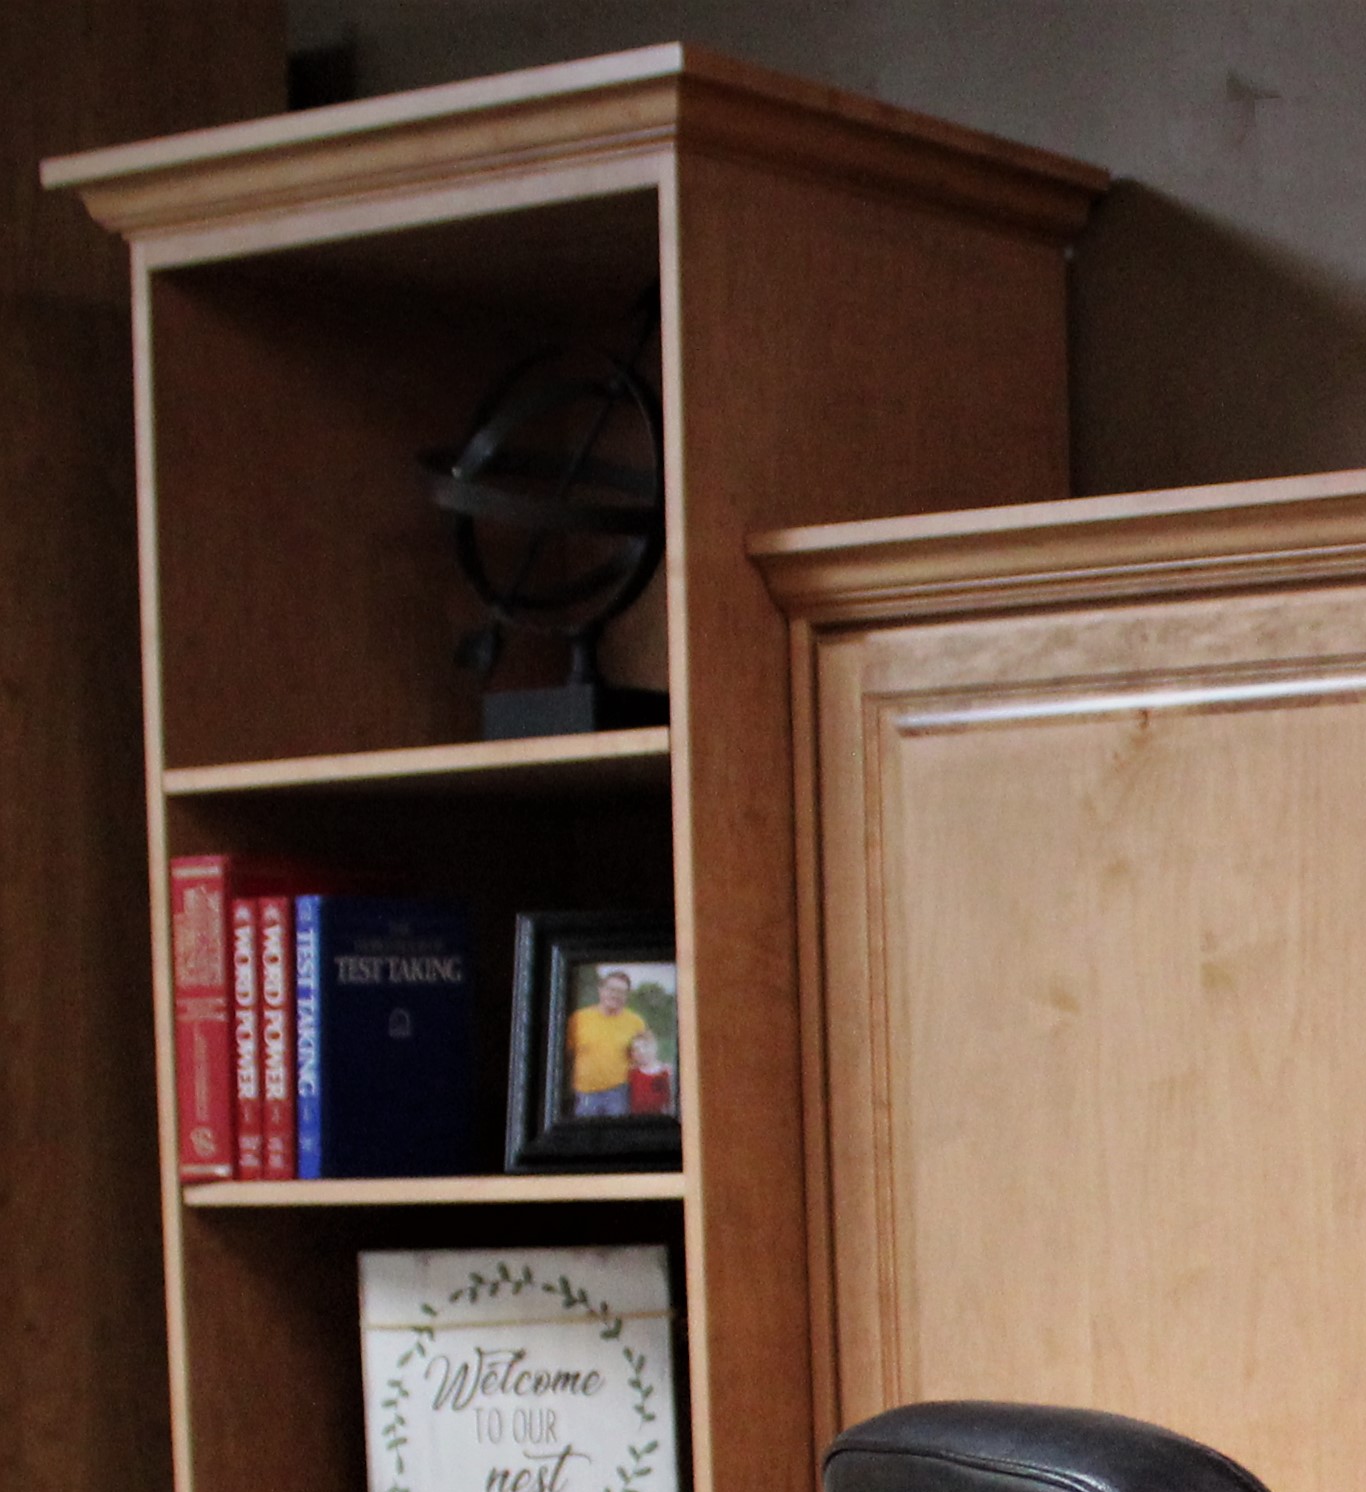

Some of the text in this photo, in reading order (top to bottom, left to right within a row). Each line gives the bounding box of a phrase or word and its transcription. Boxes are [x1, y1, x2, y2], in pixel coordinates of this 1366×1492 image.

[234, 923, 256, 1006] WORD
[262, 923, 285, 1006] WORD
[296, 927, 317, 988] TEST
[333, 956, 463, 984] TEST TAKING
[235, 1010, 259, 1099] POWER
[263, 1010, 287, 1099] POWER
[296, 994, 317, 1097] TAKING
[424, 1347, 604, 1411] Welcome
[474, 1406, 558, 1444] TO OUR
